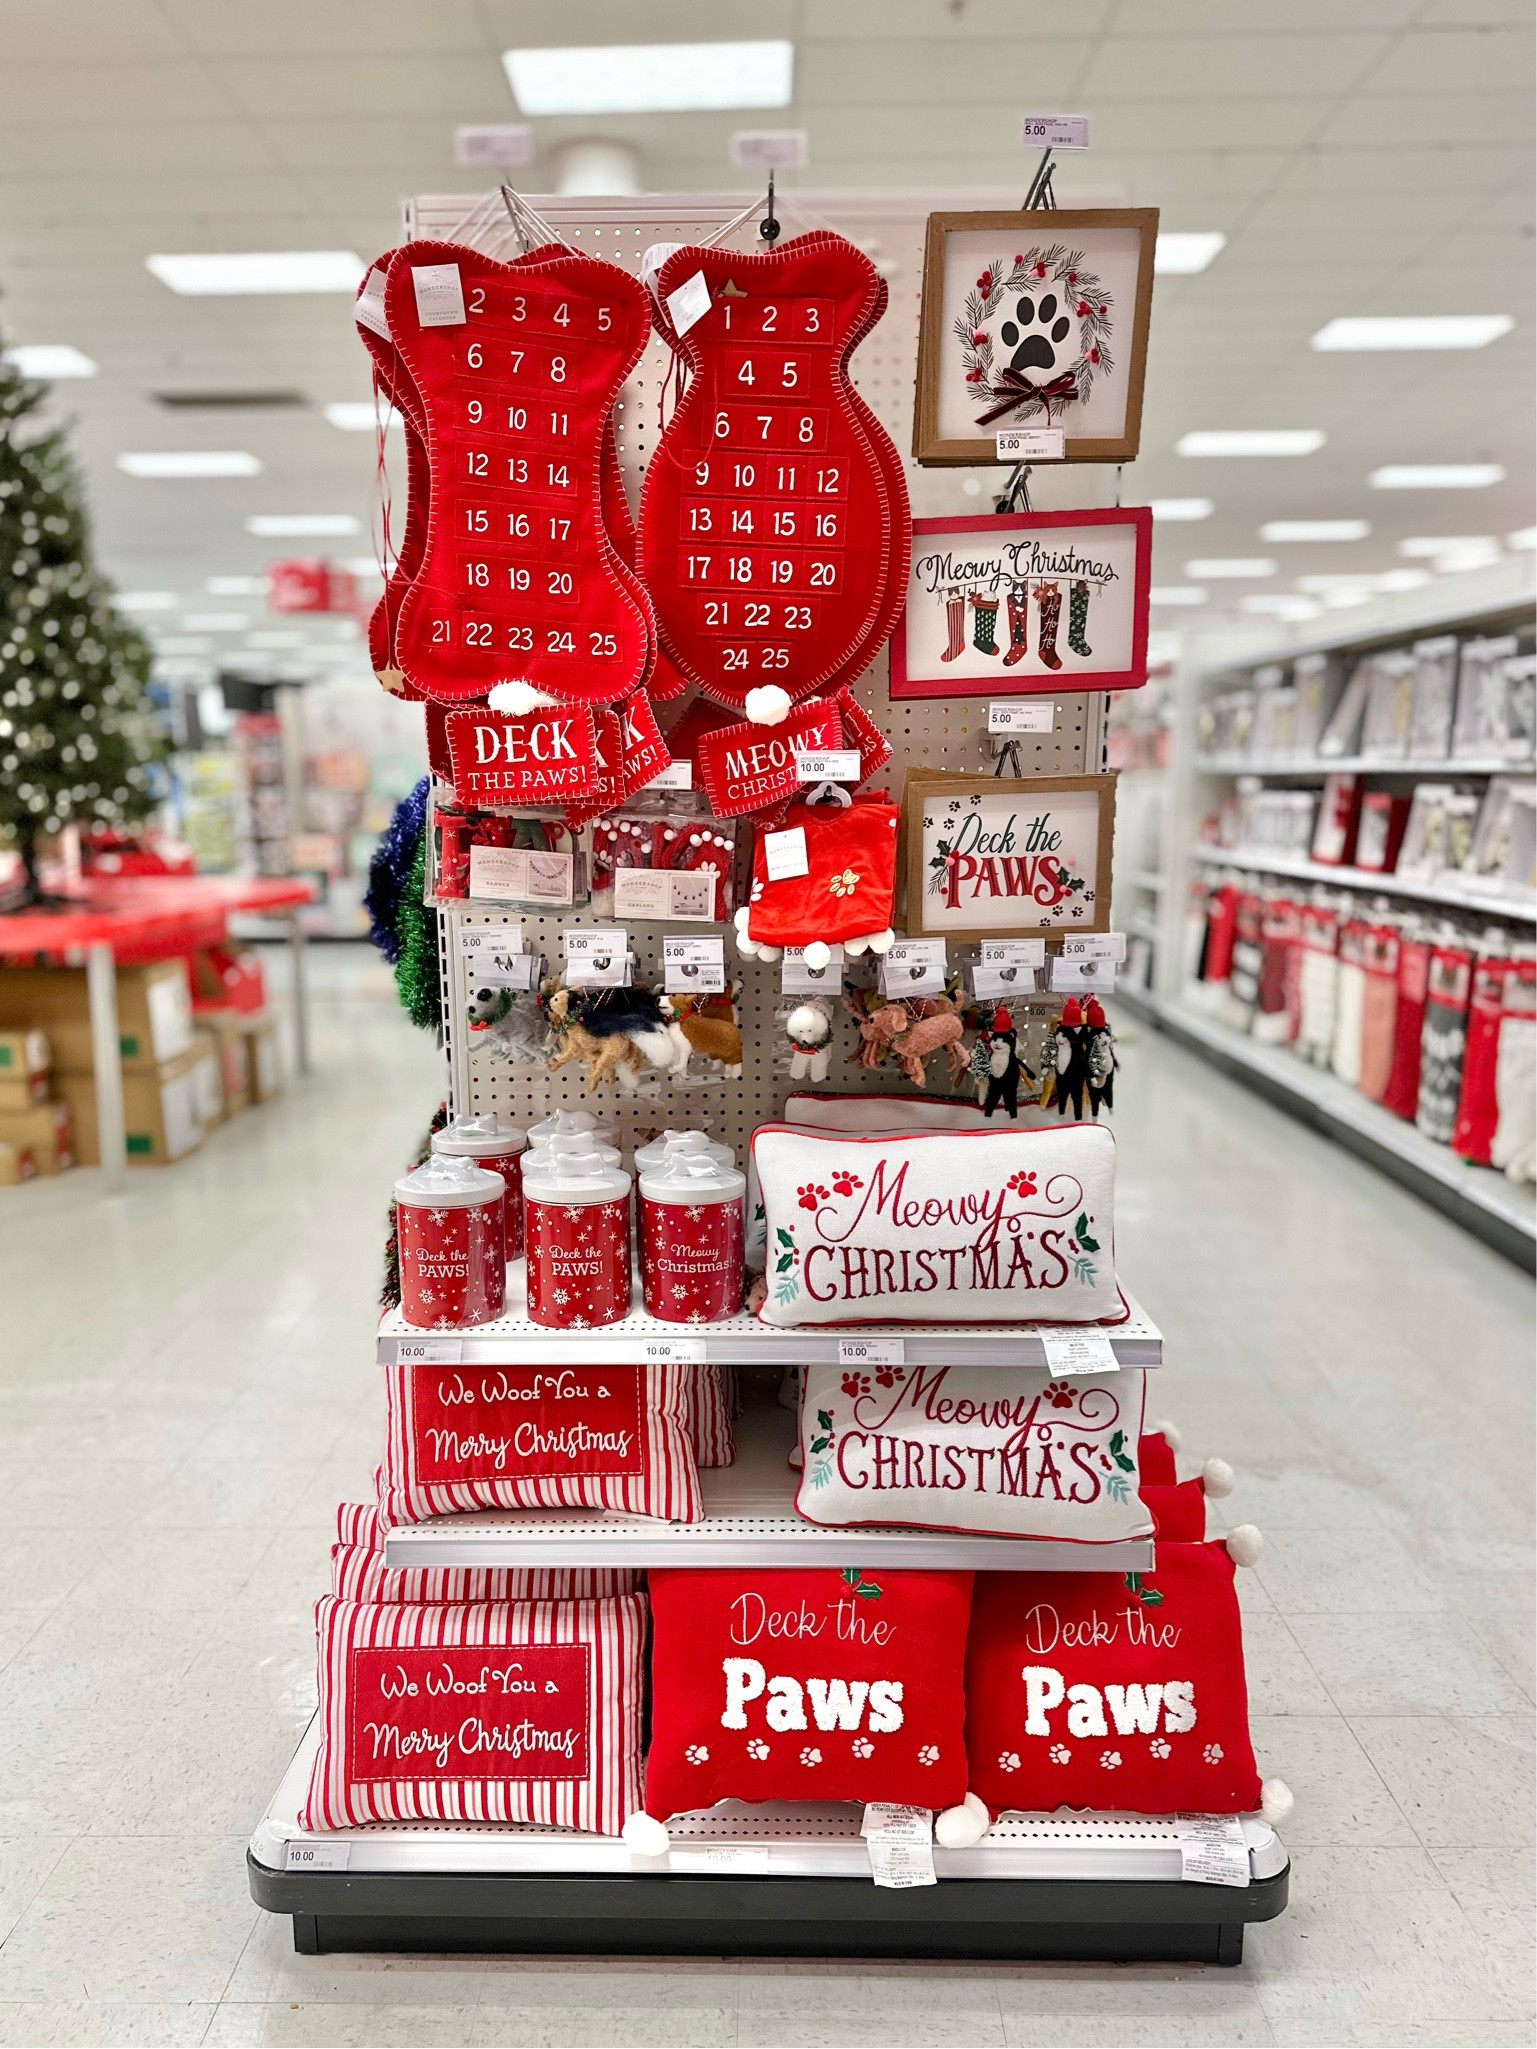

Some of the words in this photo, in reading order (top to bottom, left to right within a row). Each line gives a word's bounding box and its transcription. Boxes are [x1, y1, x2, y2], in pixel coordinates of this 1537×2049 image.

[1025, 125, 1046, 136] 5.00
[468, 288, 486, 314] 2
[511, 296, 527, 322] 3
[553, 303, 570, 327] 4
[597, 307, 612, 331] 5
[724, 305, 731, 330] 1
[761, 305, 778, 332] 2
[804, 307, 820, 332] 3
[467, 343, 483, 369] 6
[510, 351, 525, 373] 7
[550, 356, 566, 382] 8
[738, 360, 755, 385] 4
[781, 362, 798, 387] 5
[467, 400, 483, 424] 9
[507, 406, 527, 430] 10
[550, 412, 568, 435] 11
[715, 411, 730, 438] 6
[756, 416, 772, 439] 7
[798, 417, 814, 442] 8
[999, 440, 1019, 449] 5.00
[466, 451, 489, 476] 12
[507, 458, 528, 483] 13
[547, 464, 569, 488] 14
[696, 461, 709, 486] 9
[733, 465, 755, 488] 10
[777, 467, 796, 490] 11
[817, 469, 839, 493] 12
[465, 509, 489, 532] 15
[507, 513, 530, 537] 16
[549, 517, 571, 541] 17
[689, 507, 712, 531] 13
[731, 510, 754, 534] 14
[773, 512, 796, 536] 15
[815, 514, 837, 537] 16
[466, 563, 490, 587] 18
[508, 567, 530, 591] 19
[547, 571, 573, 595] 20
[687, 556, 711, 579] 17
[728, 557, 752, 583] 18
[770, 560, 793, 583] 19
[810, 563, 835, 586] 20
[916, 552, 1012, 592] Meowy
[1002, 541, 1119, 581] Christmas
[704, 602, 728, 625] 21
[744, 603, 770, 627] 22
[784, 606, 812, 629] 23
[432, 620, 450, 642] 21
[465, 622, 493, 646] 22
[508, 627, 533, 650] 23
[547, 631, 576, 653] 24
[589, 632, 617, 656] 25
[722, 649, 749, 670] 24
[761, 648, 789, 669] 25
[992, 714, 1011, 723] 5.00
[474, 719, 577, 764] DECK
[725, 723, 828, 780] MEOWY
[468, 772, 515, 791] THE
[521, 766, 586, 788] PAWS!
[727, 765, 798, 800] CHRIST
[800, 763, 825, 772] 10.00
[950, 813, 1017, 855] Deck
[1026, 813, 1063, 853] the
[945, 855, 1065, 909] PAWS
[462, 938, 481, 947] 5.00
[569, 940, 588, 949] 5.00
[666, 947, 685, 957] 5.00
[888, 950, 907, 959] 5.00
[986, 950, 1005, 960] 5.00
[1066, 944, 1085, 953] 5.00
[1029, 1008, 1046, 1016] 5.00
[815, 1160, 1084, 1251] Meowy
[415, 1248, 449, 1264] Deck
[450, 1248, 469, 1262] the
[548, 1244, 584, 1261] Deck
[585, 1246, 603, 1259] the
[670, 1243, 721, 1262] Meowy
[804, 1228, 1070, 1302] CHRISTMAS
[418, 1263, 470, 1278] PAWS!
[551, 1260, 604, 1277] PAWS!
[400, 1347, 425, 1356] 10.00
[646, 1346, 671, 1355] 10.00
[842, 1347, 867, 1356] 10.00
[438, 1374, 475, 1407] We
[481, 1371, 543, 1404] Woof
[545, 1370, 589, 1400] You
[597, 1385, 611, 1399] a
[854, 1365, 1119, 1458] Meowy
[425, 1427, 511, 1470] Merry
[514, 1421, 634, 1459] Christmas
[837, 1430, 1102, 1505] CHRISTMAS
[730, 1592, 828, 1645] Deck
[827, 1598, 897, 1646] the
[1025, 1604, 1119, 1654] Deck
[1116, 1607, 1182, 1648] the
[380, 1665, 420, 1700] We
[426, 1663, 489, 1697] Woof
[491, 1663, 537, 1695] You
[544, 1680, 560, 1695] a
[721, 1657, 905, 1733] Paws
[1021, 1665, 1197, 1739] Paws
[363, 1722, 455, 1768] Merry
[458, 1717, 580, 1758] Christmas
[290, 1851, 314, 1861] 10.00
